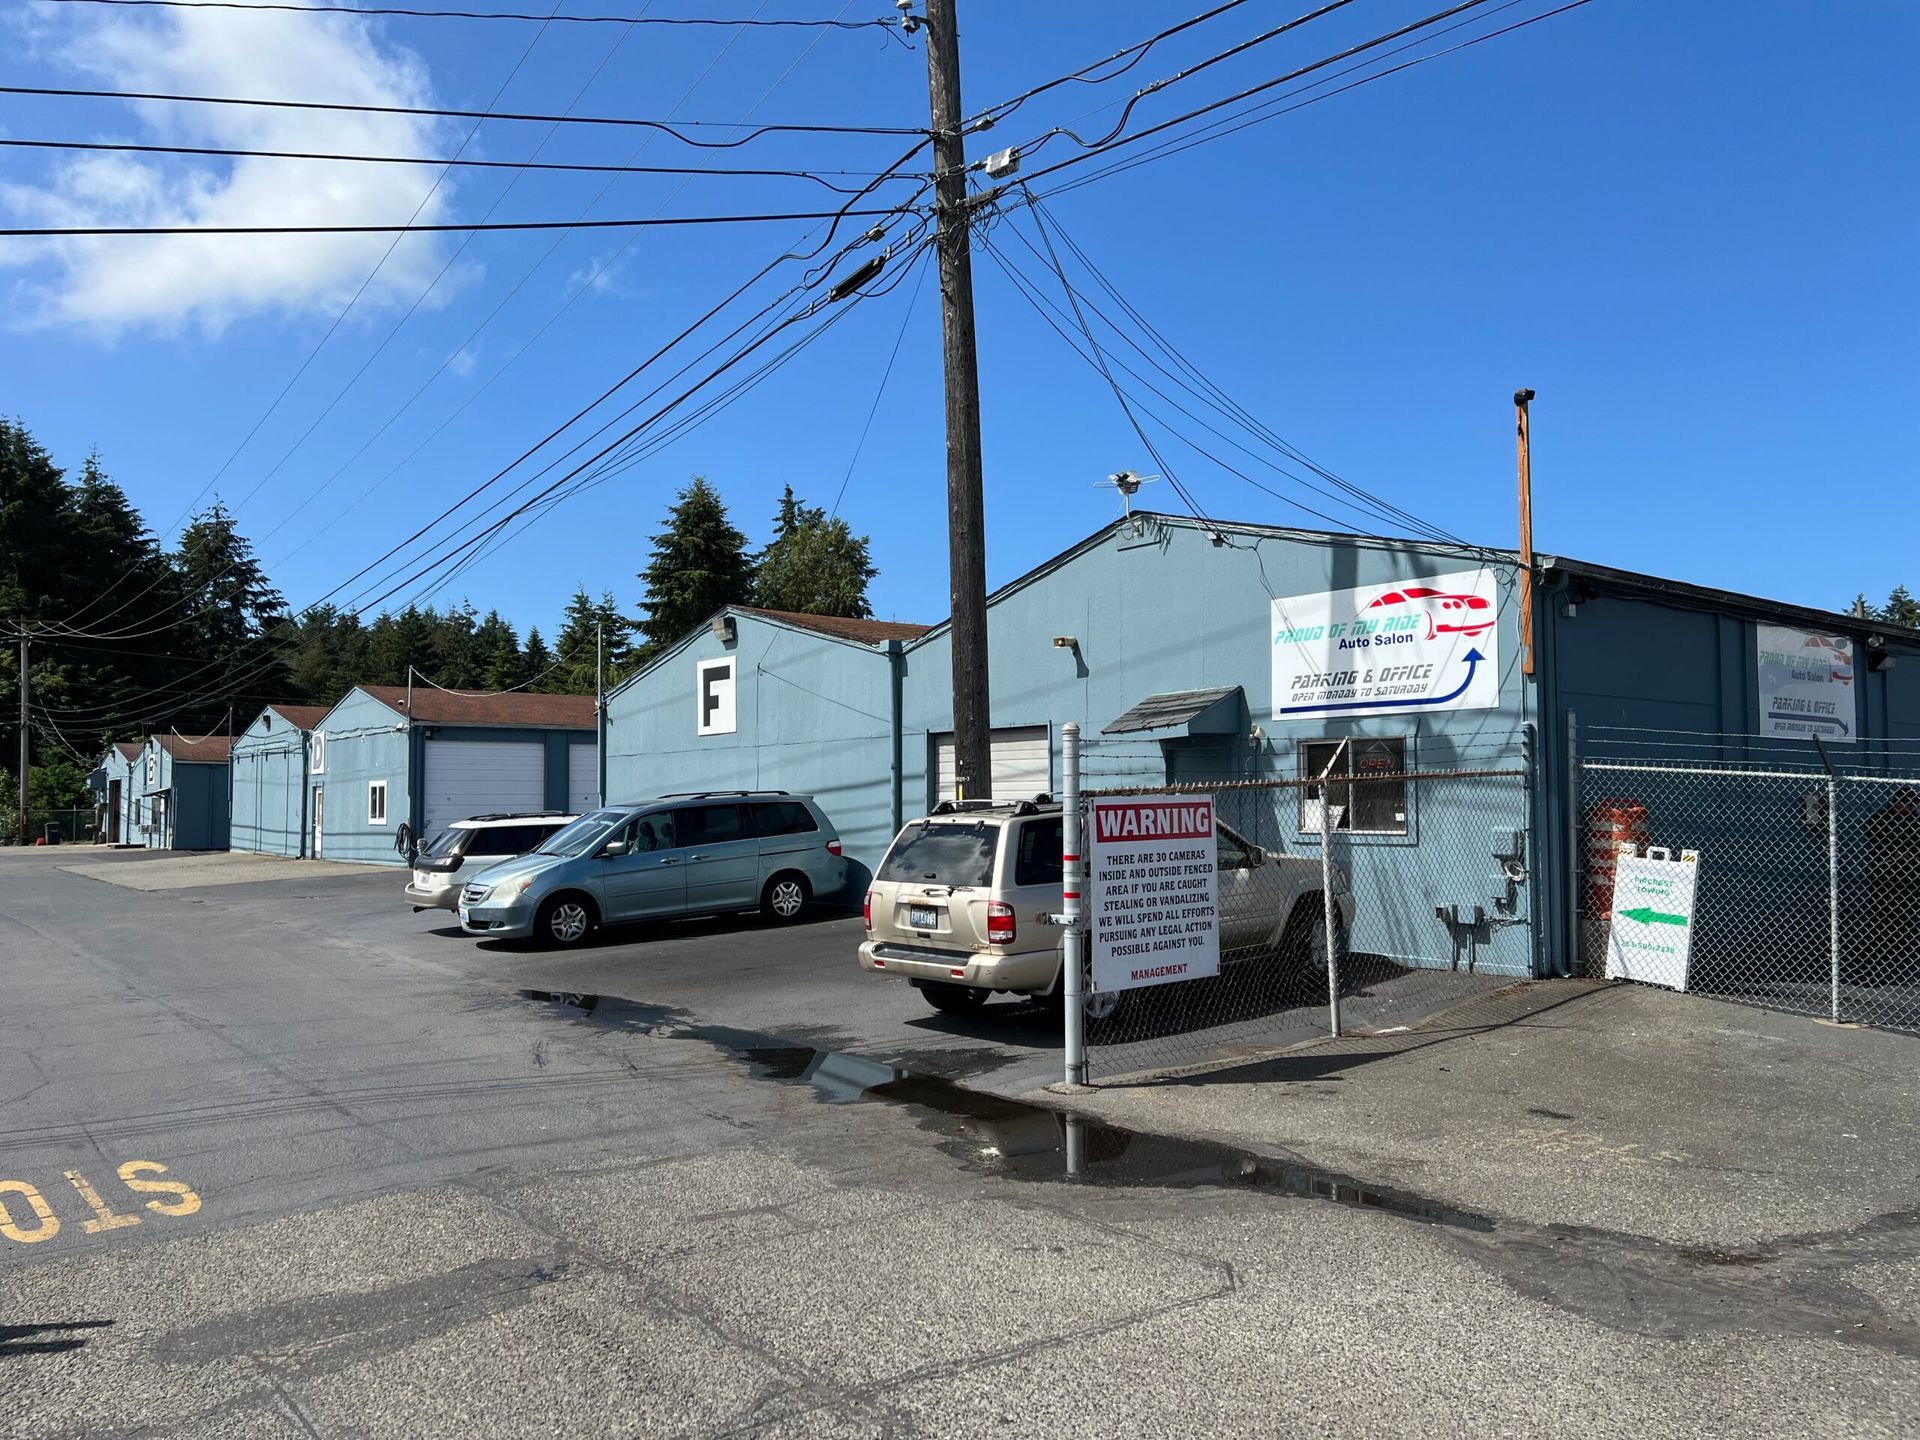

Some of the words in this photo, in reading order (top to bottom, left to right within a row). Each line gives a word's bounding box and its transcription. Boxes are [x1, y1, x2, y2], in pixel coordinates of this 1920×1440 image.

[1275, 626, 1324, 644] PROUD
[1328, 622, 1348, 639] OF
[1351, 619, 1379, 636] MY
[1383, 613, 1422, 632] RIDE
[1338, 638, 1370, 650] Auto
[1374, 633, 1414, 646] Salon
[1291, 670, 1359, 690] PARKING
[1363, 669, 1373, 683] &
[1379, 663, 1434, 682] OFFICE
[703, 665, 730, 727] F
[1291, 692, 1314, 702] OPEN
[1316, 688, 1357, 701] MONDAY
[1360, 687, 1373, 697] TO
[1374, 683, 1428, 696] SATURDAY
[1772, 697, 1806, 712] PARKING
[313, 735, 323, 770] D
[1360, 758, 1394, 769] OPEN
[1099, 807, 1209, 837] WARNING
[1107, 854, 1135, 866] THERE
[1137, 853, 1154, 863] ARE
[1156, 852, 1167, 862] 30
[1169, 849, 1206, 861] CAMERAS
[1098, 869, 1127, 881] INSIDE
[1129, 868, 1146, 879] AND
[1148, 865, 1182, 878] OUTSIDE
[1184, 863, 1213, 875] FENCED
[1106, 883, 1129, 896] AREA
[1131, 883, 1139, 893] IF
[1141, 881, 1157, 893] YOU
[1159, 880, 1176, 892] ARE
[1177, 878, 1207, 890] CAUGHT
[1104, 900, 1144, 912] STEALING
[1146, 897, 1158, 908] OR
[1159, 892, 1210, 906] VANDALIZING
[1099, 915, 1113, 927] WE
[1115, 914, 1135, 926] WILL
[1137, 911, 1163, 924] SPEND
[1165, 909, 1180, 921] ALL
[1182, 906, 1215, 919] EFFORTS
[1099, 928, 1138, 943] PURSUING
[1140, 926, 1156, 938] ANY
[1158, 922, 1183, 936] LEGAL
[1185, 920, 1212, 933] ACTION
[1111, 942, 1151, 957] POSSIBLE
[1152, 938, 1186, 952] AGAINST
[1188, 936, 1205, 947] YOU.
[1131, 963, 1188, 981] MANAGEMENT
